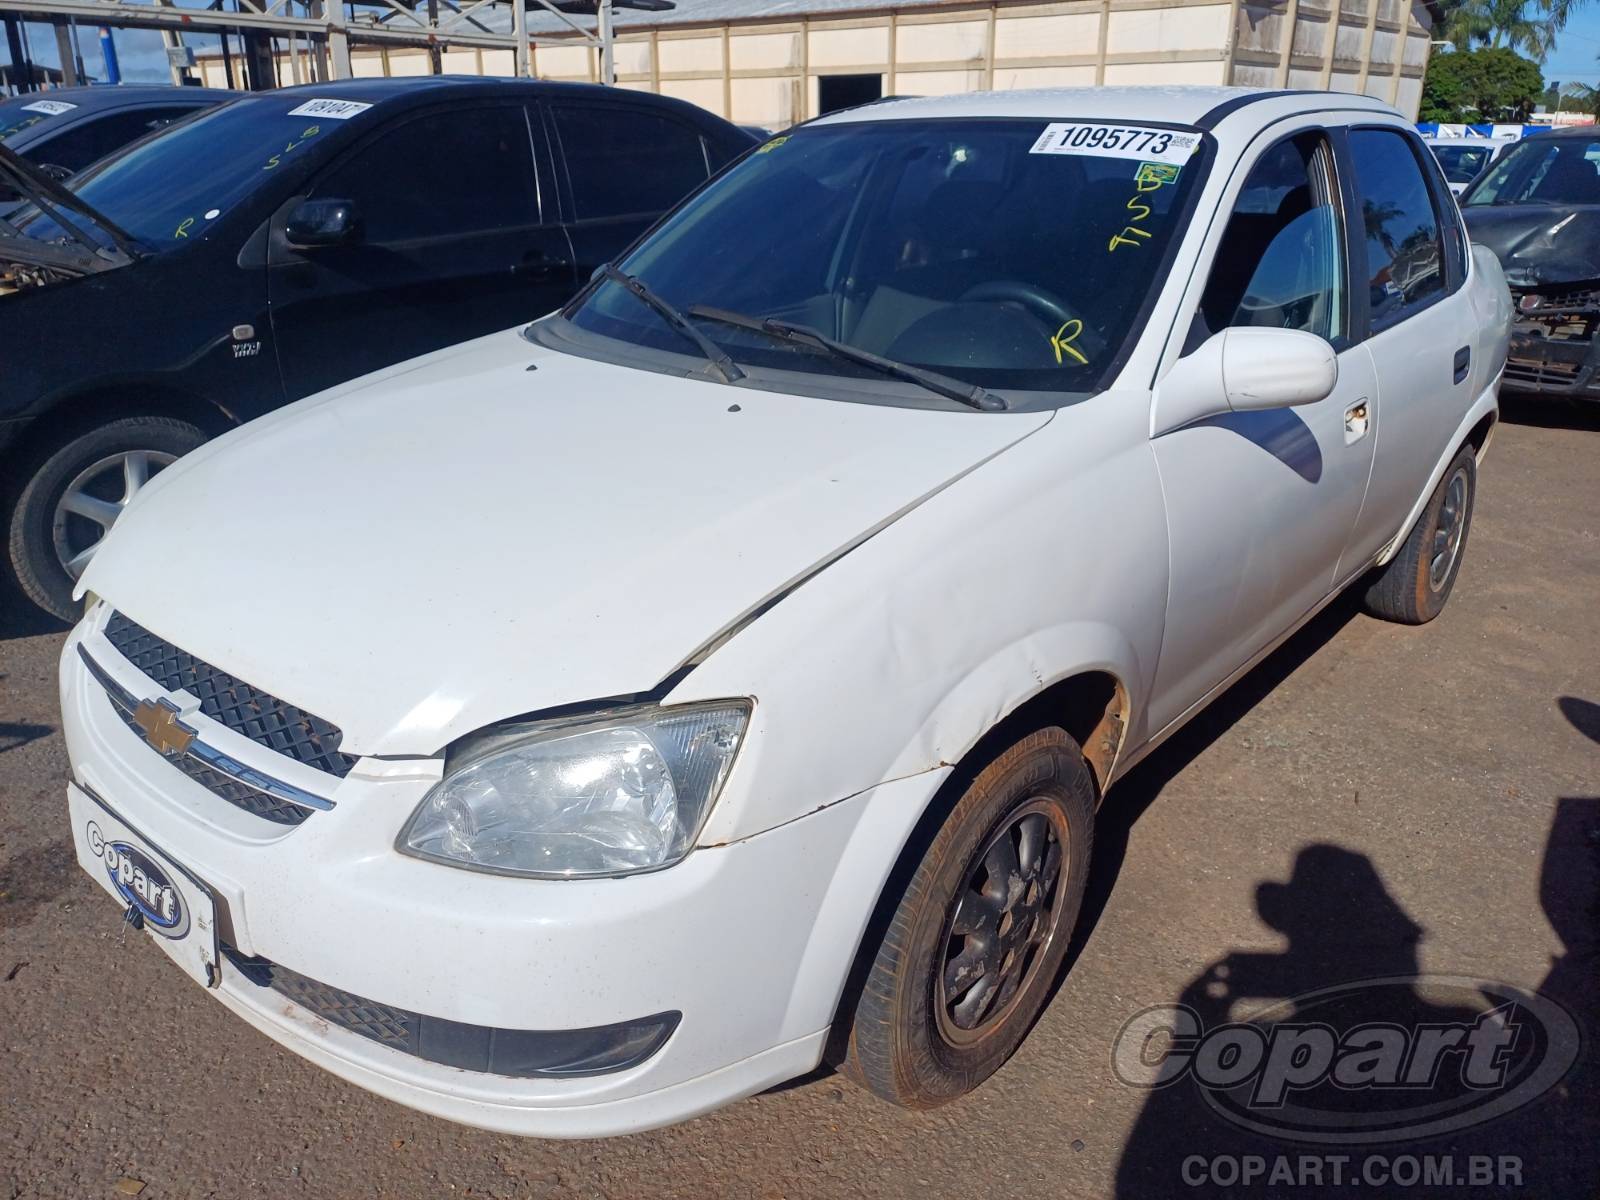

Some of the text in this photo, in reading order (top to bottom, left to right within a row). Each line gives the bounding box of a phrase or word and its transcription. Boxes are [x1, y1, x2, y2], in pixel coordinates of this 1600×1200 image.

[1060, 126, 1173, 154] 1095773
[174, 217, 195, 239] R
[1050, 319, 1089, 364] R
[86, 820, 176, 925] Copart
